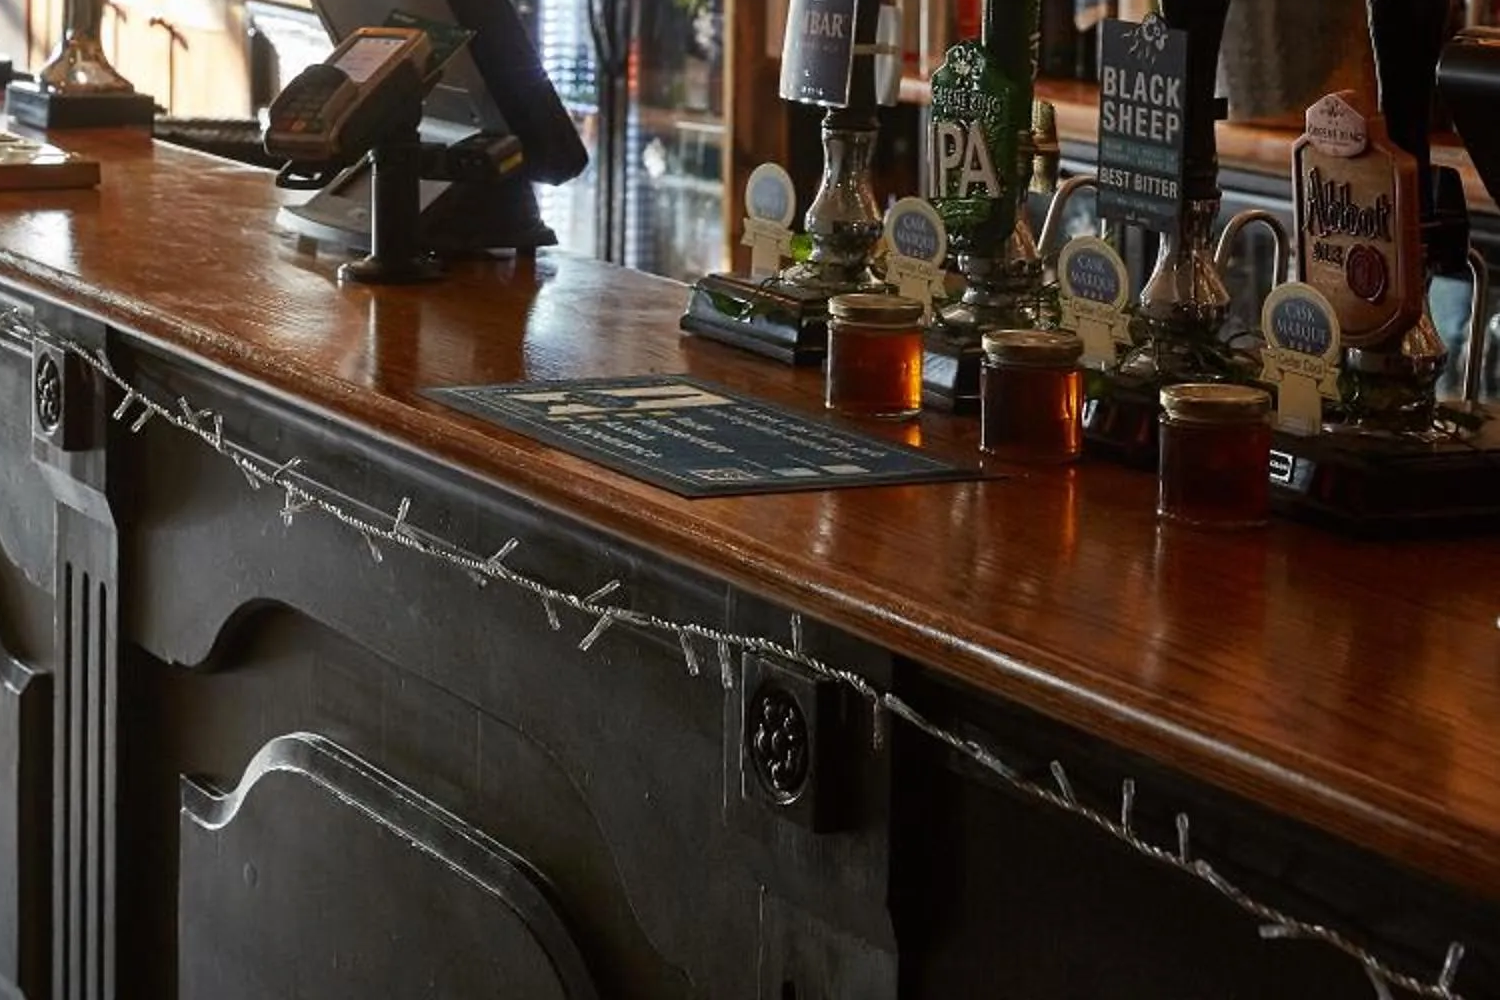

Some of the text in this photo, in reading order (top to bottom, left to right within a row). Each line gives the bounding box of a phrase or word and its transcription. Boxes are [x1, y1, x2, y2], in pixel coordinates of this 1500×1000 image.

[1103, 65, 1181, 109] BLACK
[1102, 100, 1180, 143] SHEEP
[928, 120, 1001, 199] IPA
[1100, 167, 1179, 199] BEST BITTER
[1285, 304, 1316, 323] CASK
